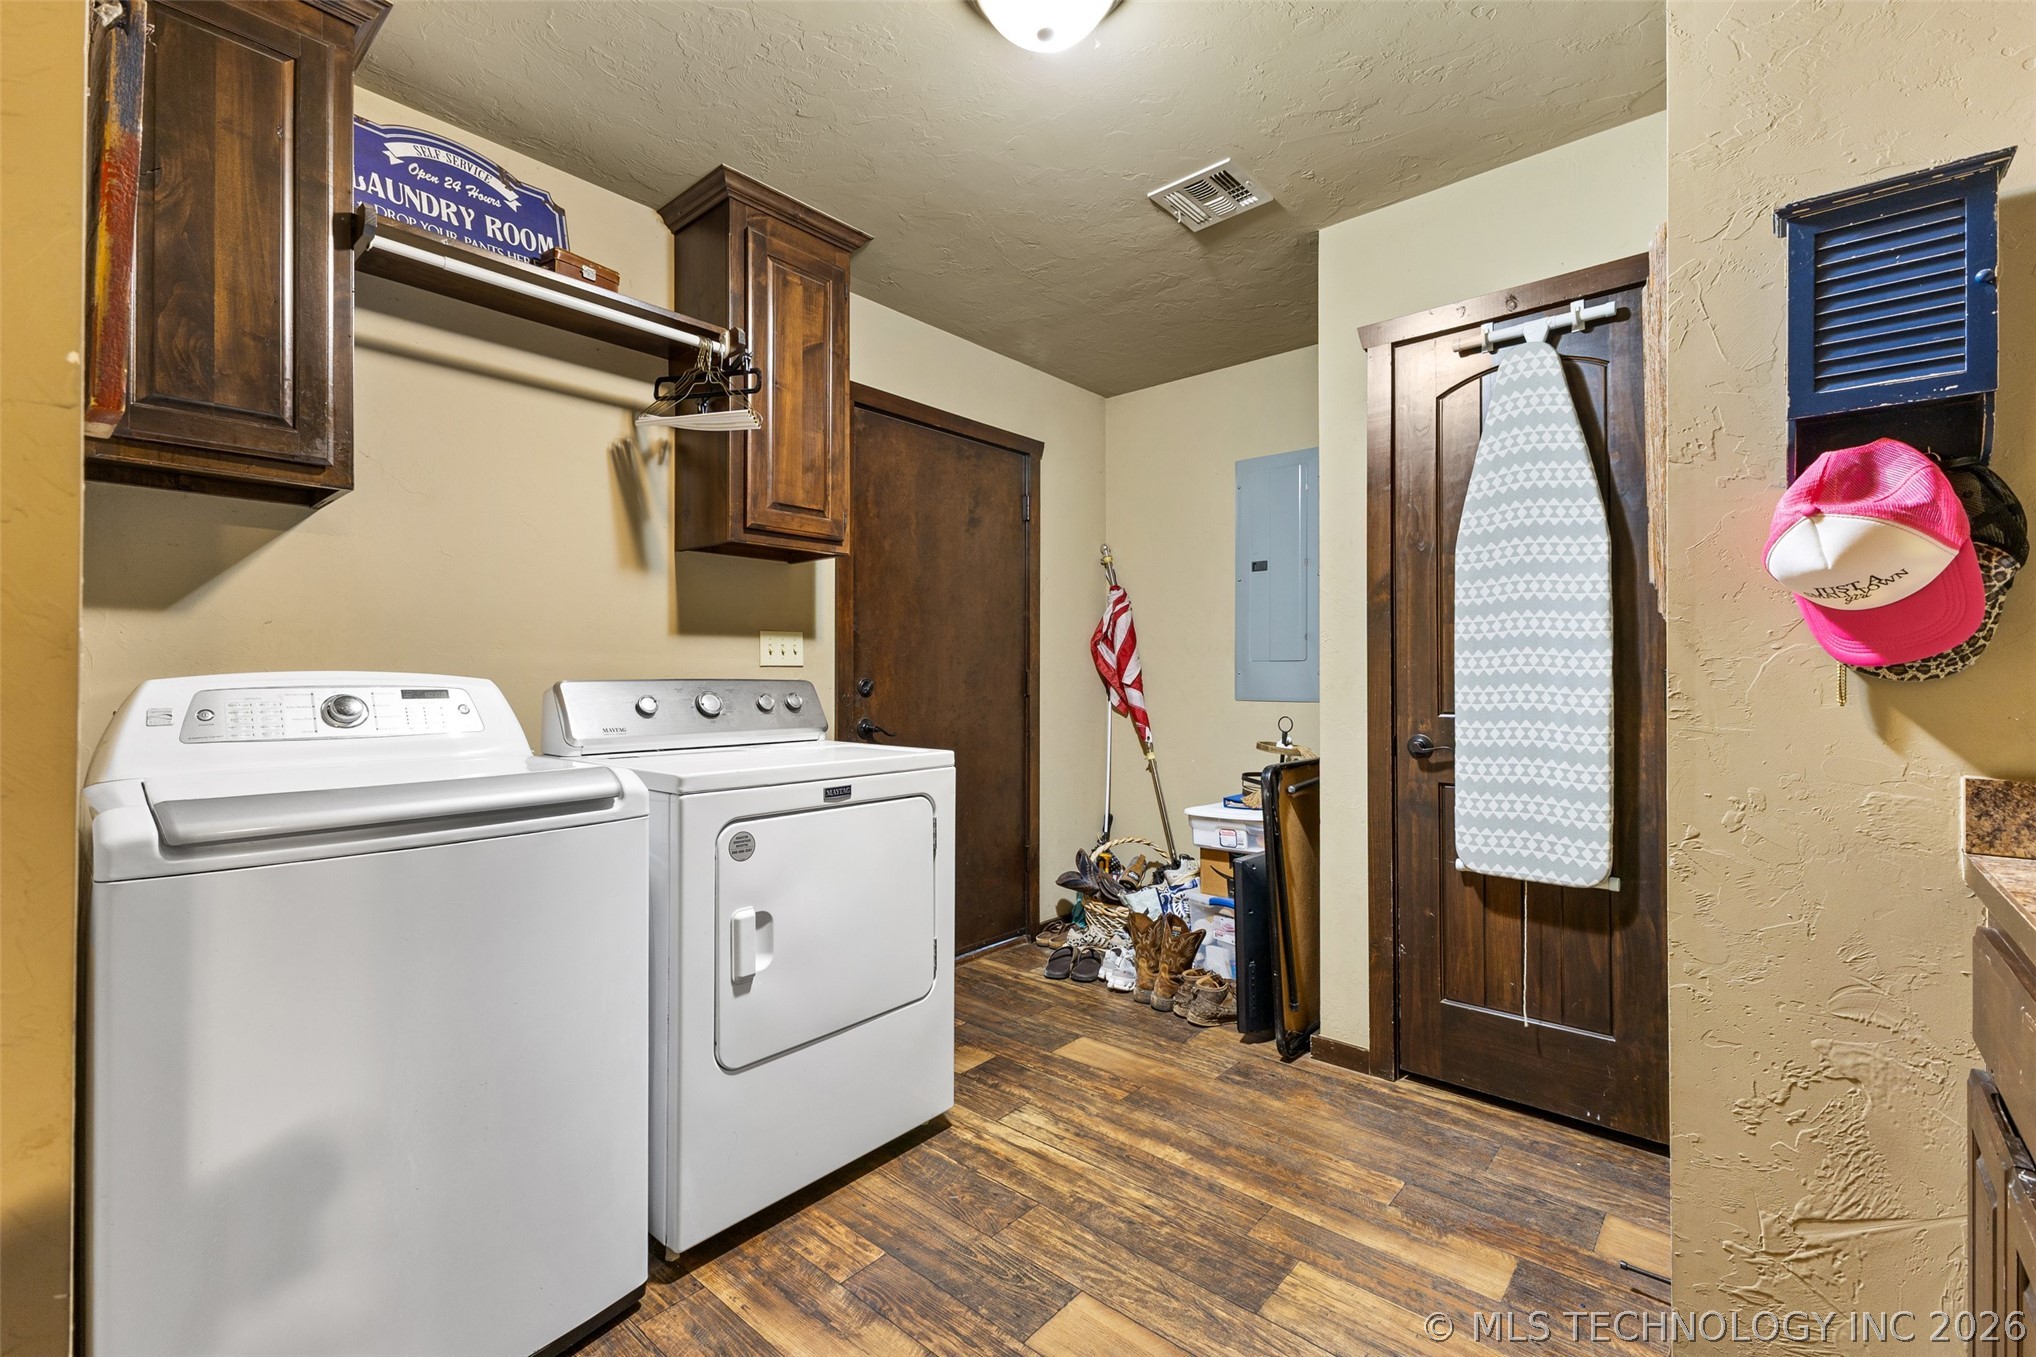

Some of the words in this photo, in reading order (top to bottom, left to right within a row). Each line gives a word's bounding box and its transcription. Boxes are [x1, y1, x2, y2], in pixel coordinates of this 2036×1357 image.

[408, 163, 440, 184] Open
[443, 176, 461, 192] 24
[465, 184, 502, 208] Hours
[485, 214, 554, 255] ROOM
[1813, 580, 1860, 598] JUST
[826, 786, 851, 797] MAYTAG
